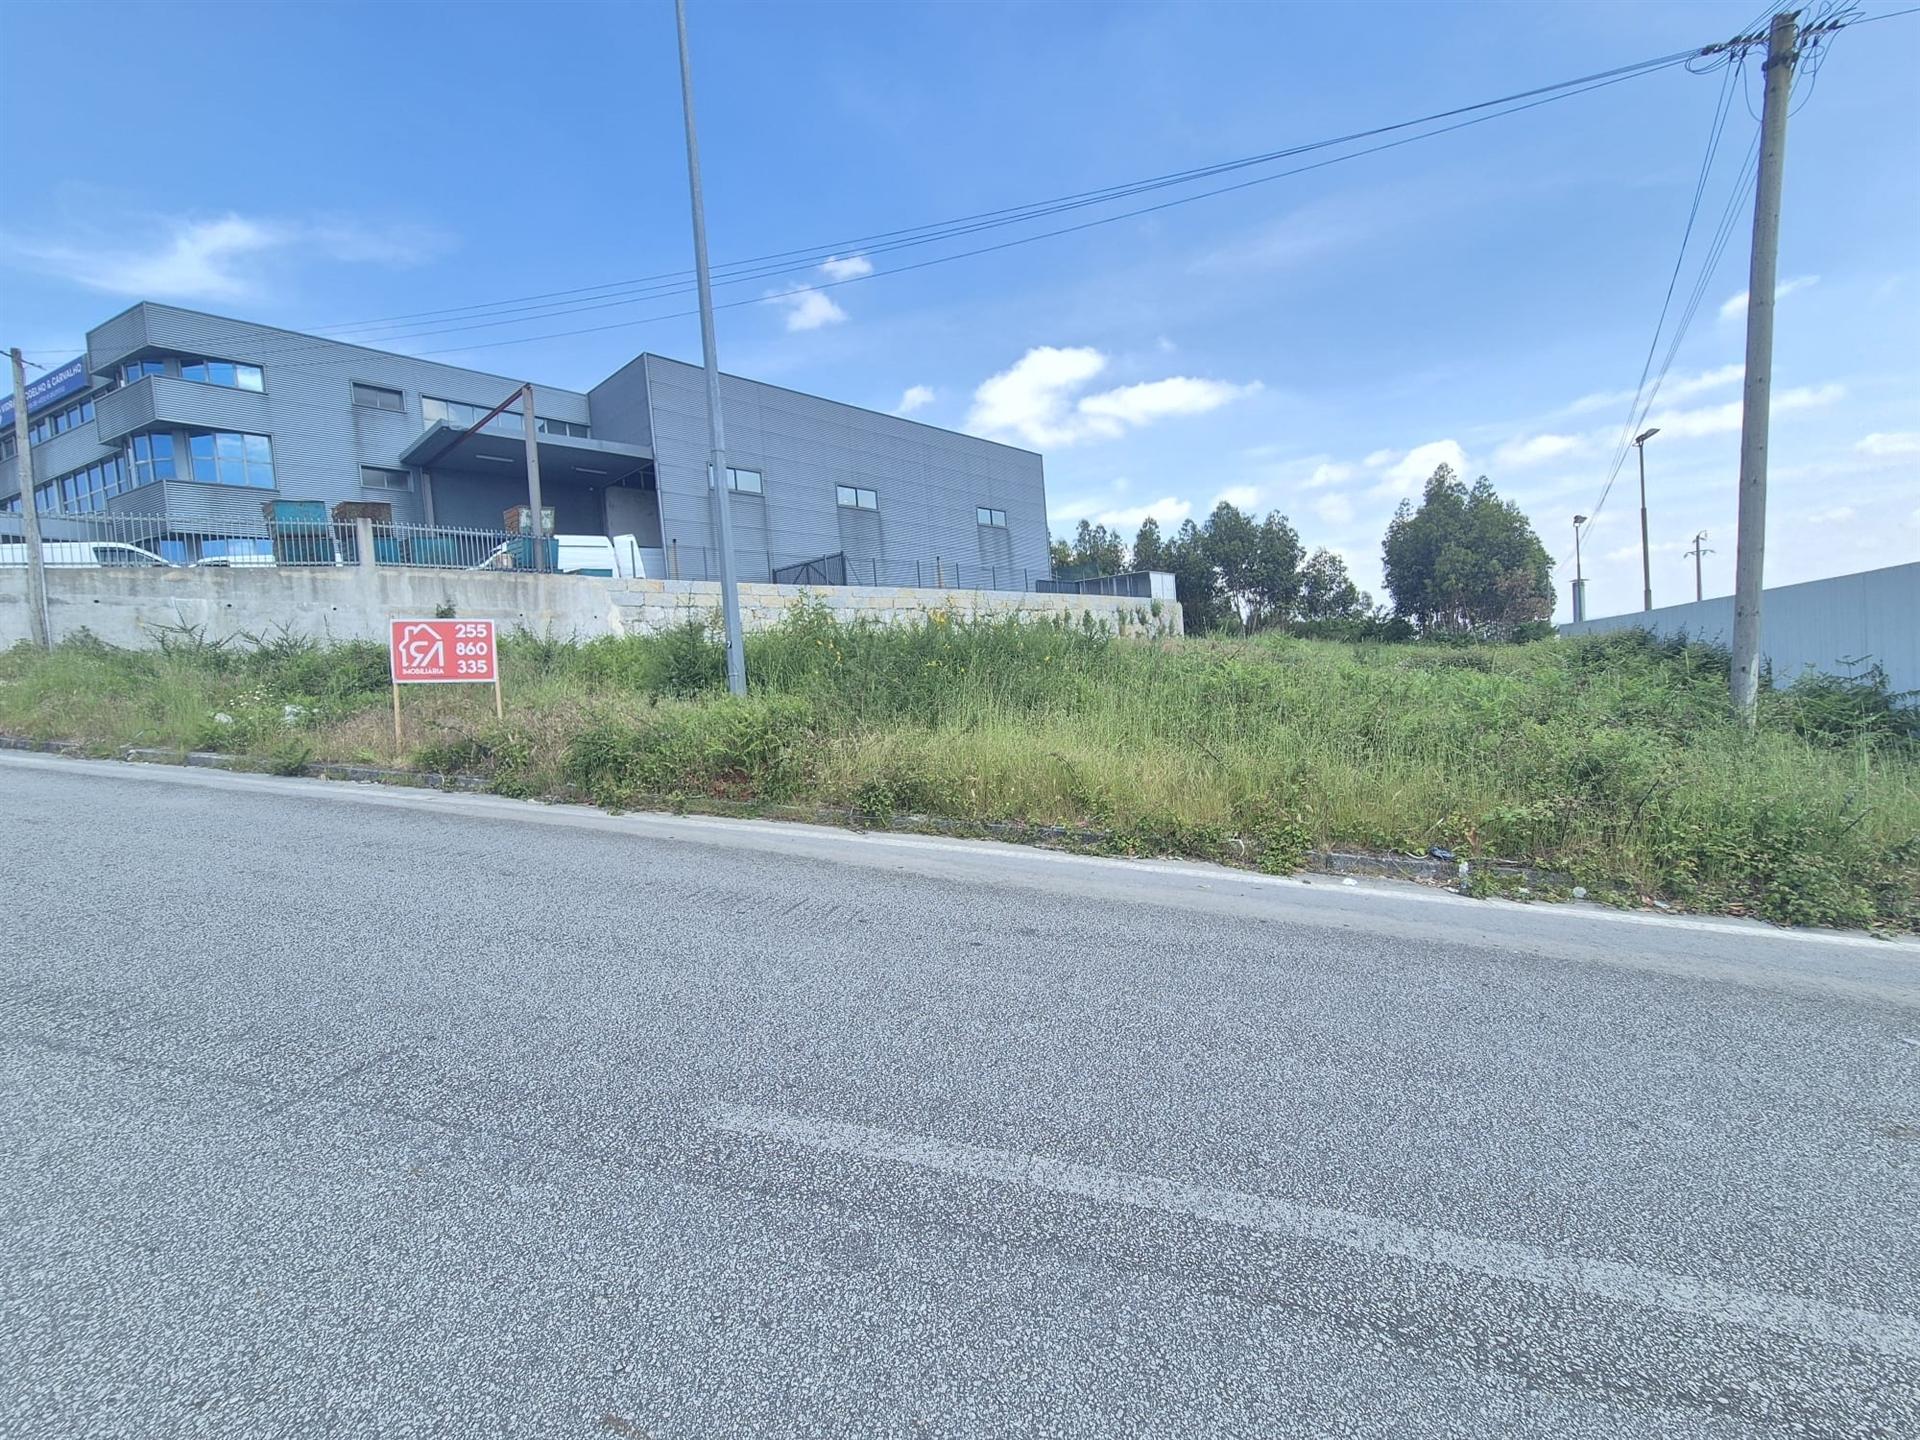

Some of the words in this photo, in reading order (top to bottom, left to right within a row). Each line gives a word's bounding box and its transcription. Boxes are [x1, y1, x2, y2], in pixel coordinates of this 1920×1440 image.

[51, 363, 81, 386] CARVALHO
[455, 624, 488, 638] 255
[455, 641, 488, 656] 860
[457, 659, 488, 673] 335
